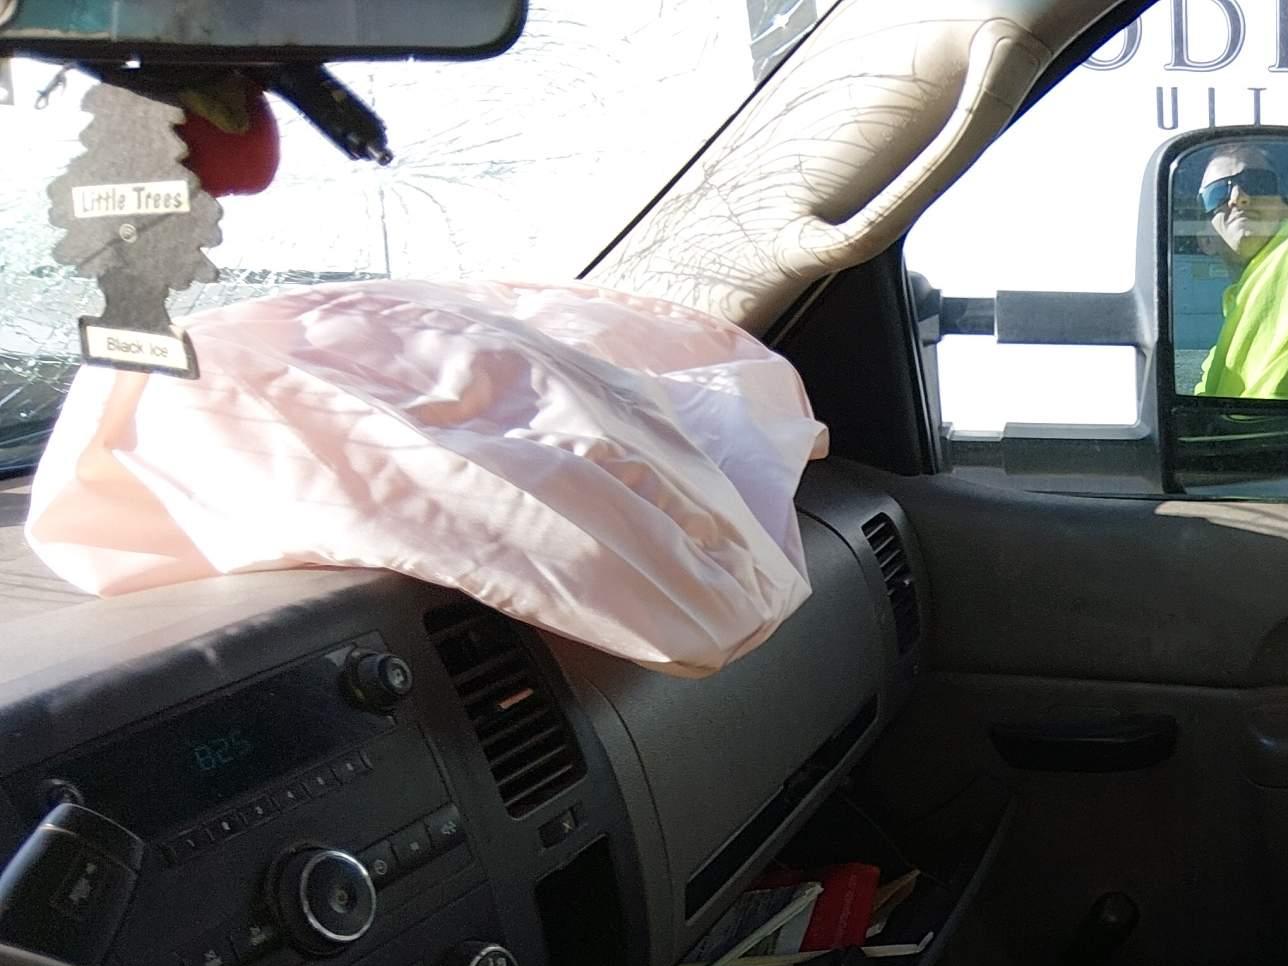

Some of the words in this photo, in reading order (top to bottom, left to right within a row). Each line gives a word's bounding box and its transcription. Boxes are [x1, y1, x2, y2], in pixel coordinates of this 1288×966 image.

[81, 188, 126, 213] Little
[132, 186, 184, 211] Trees
[106, 336, 144, 354] Black
